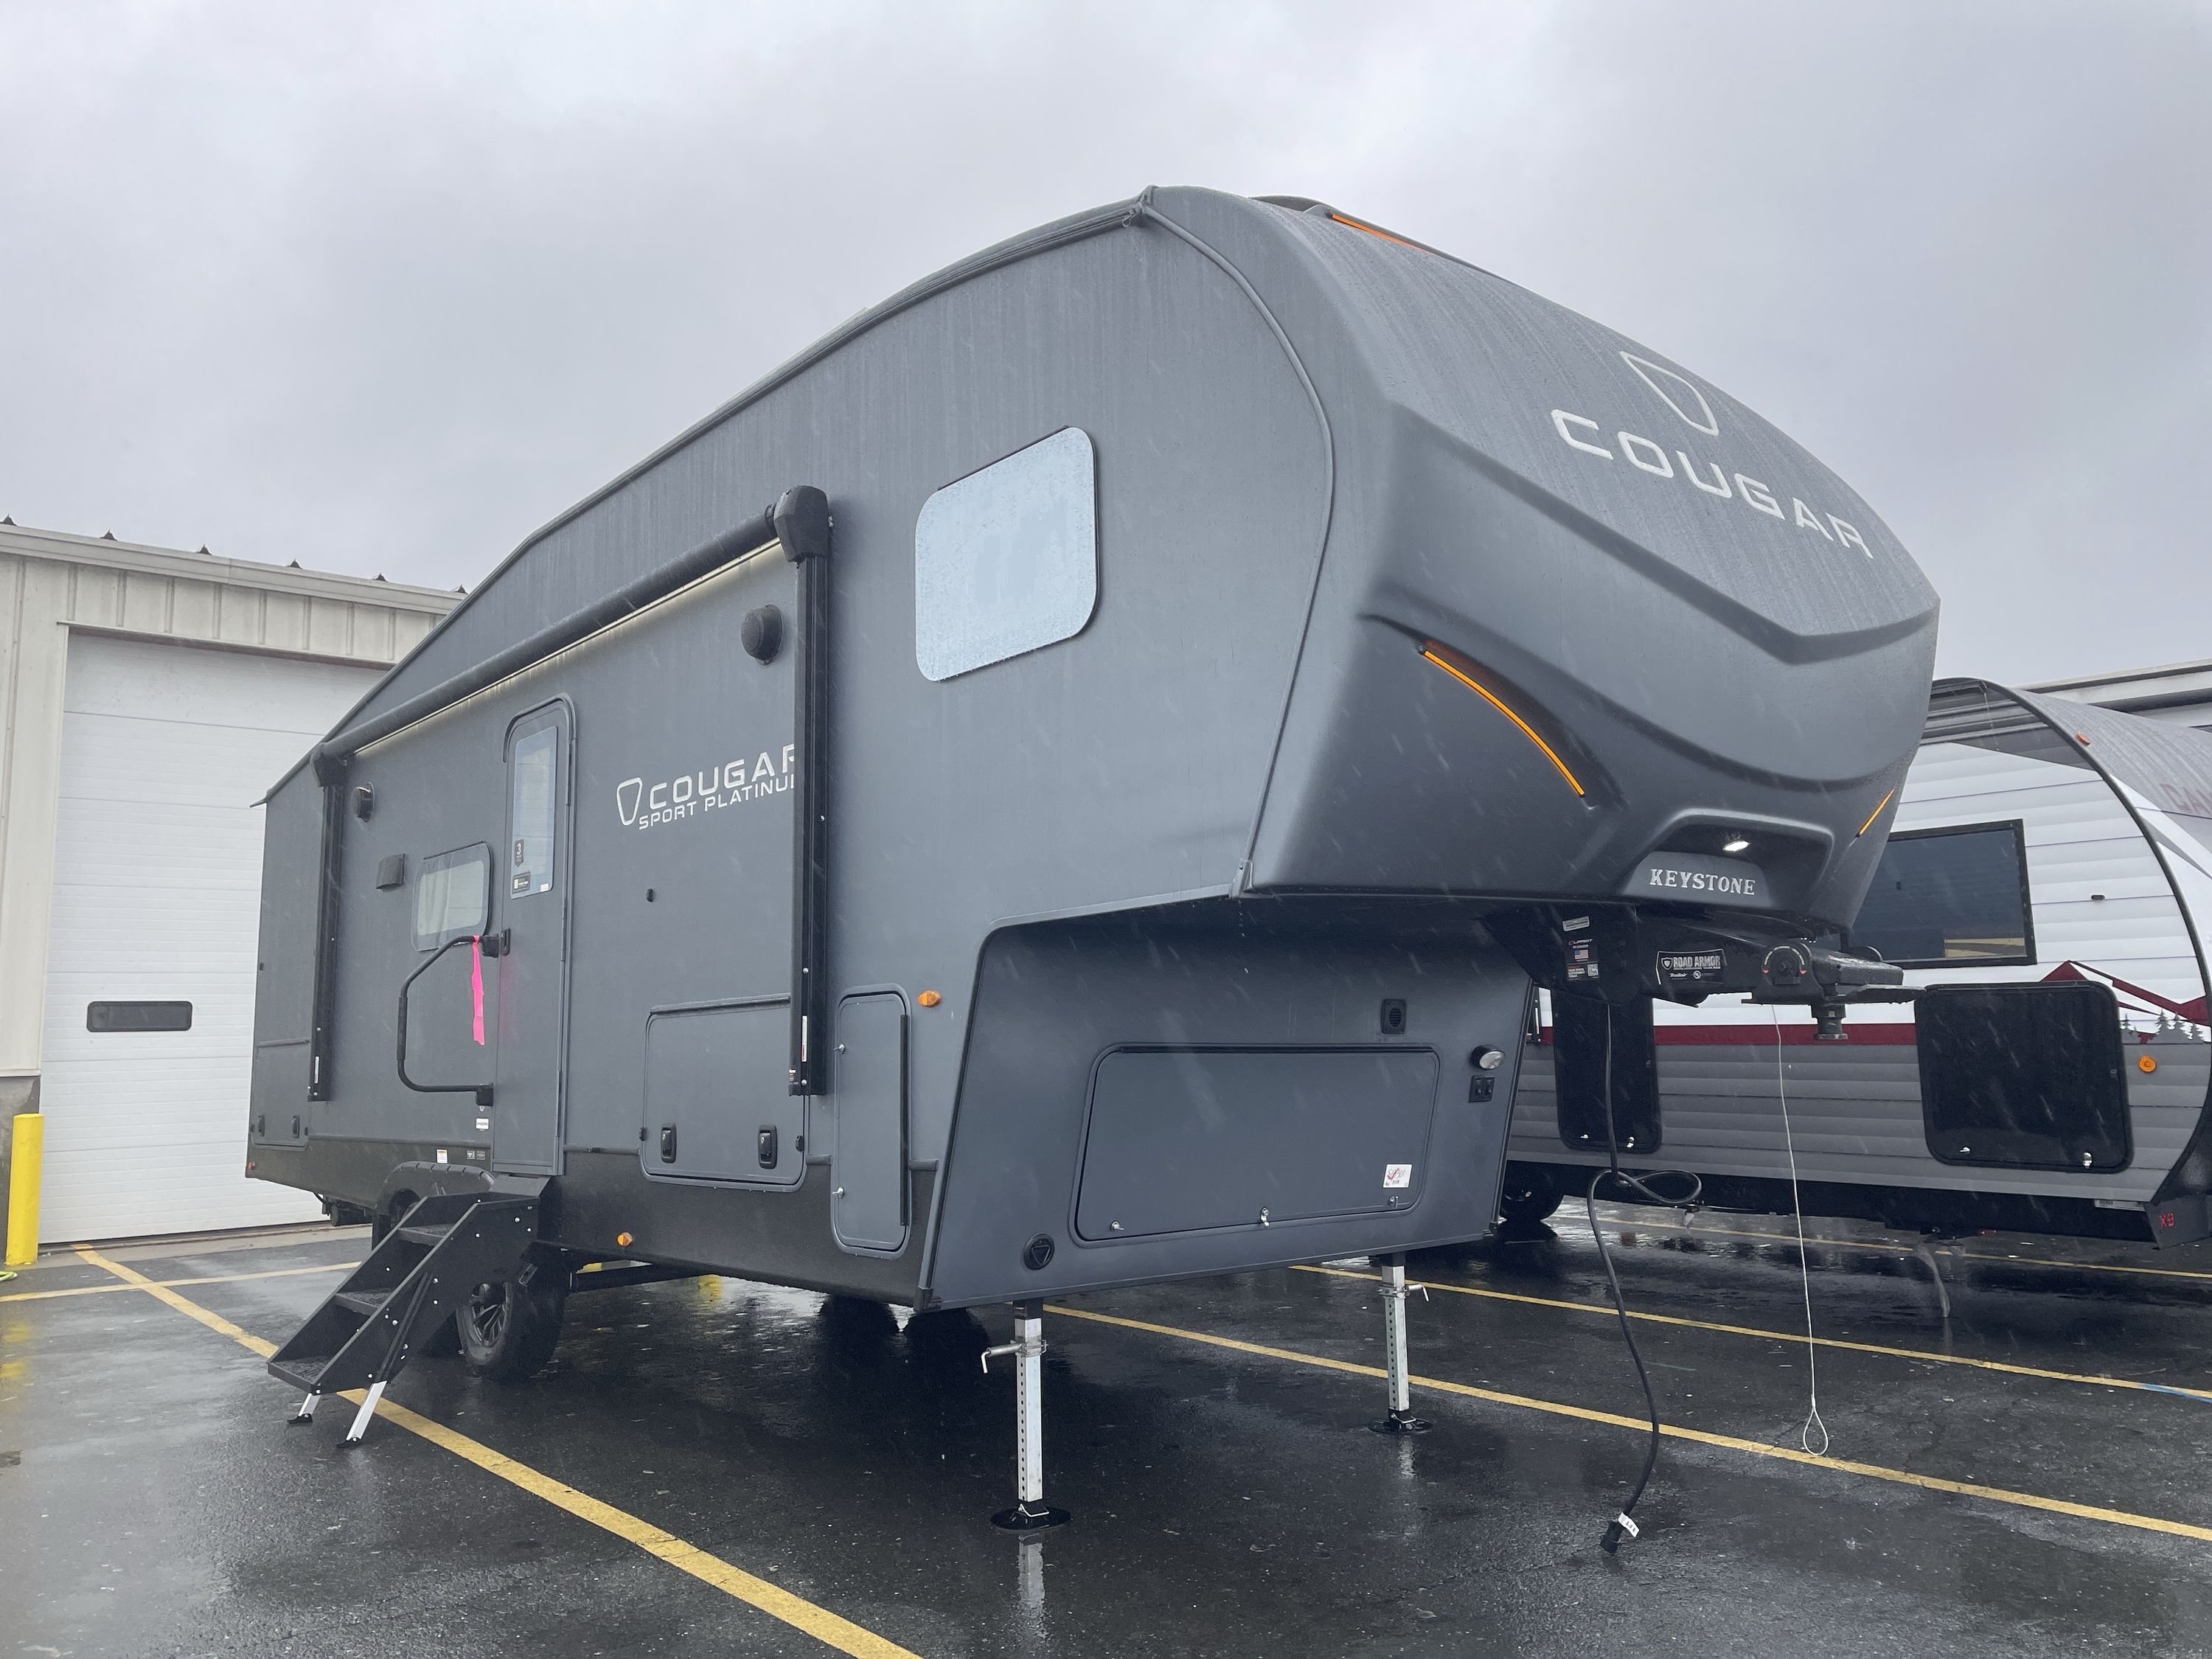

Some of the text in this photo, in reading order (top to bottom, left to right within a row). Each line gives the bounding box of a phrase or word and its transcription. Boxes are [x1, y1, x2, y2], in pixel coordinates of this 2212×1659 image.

[1551, 408, 1874, 559] COUGAR
[639, 773, 795, 830] SPORT PLATINU
[1649, 869, 1756, 895] KEYSTONE
[1673, 955, 1721, 967] ROAD ARMOR
